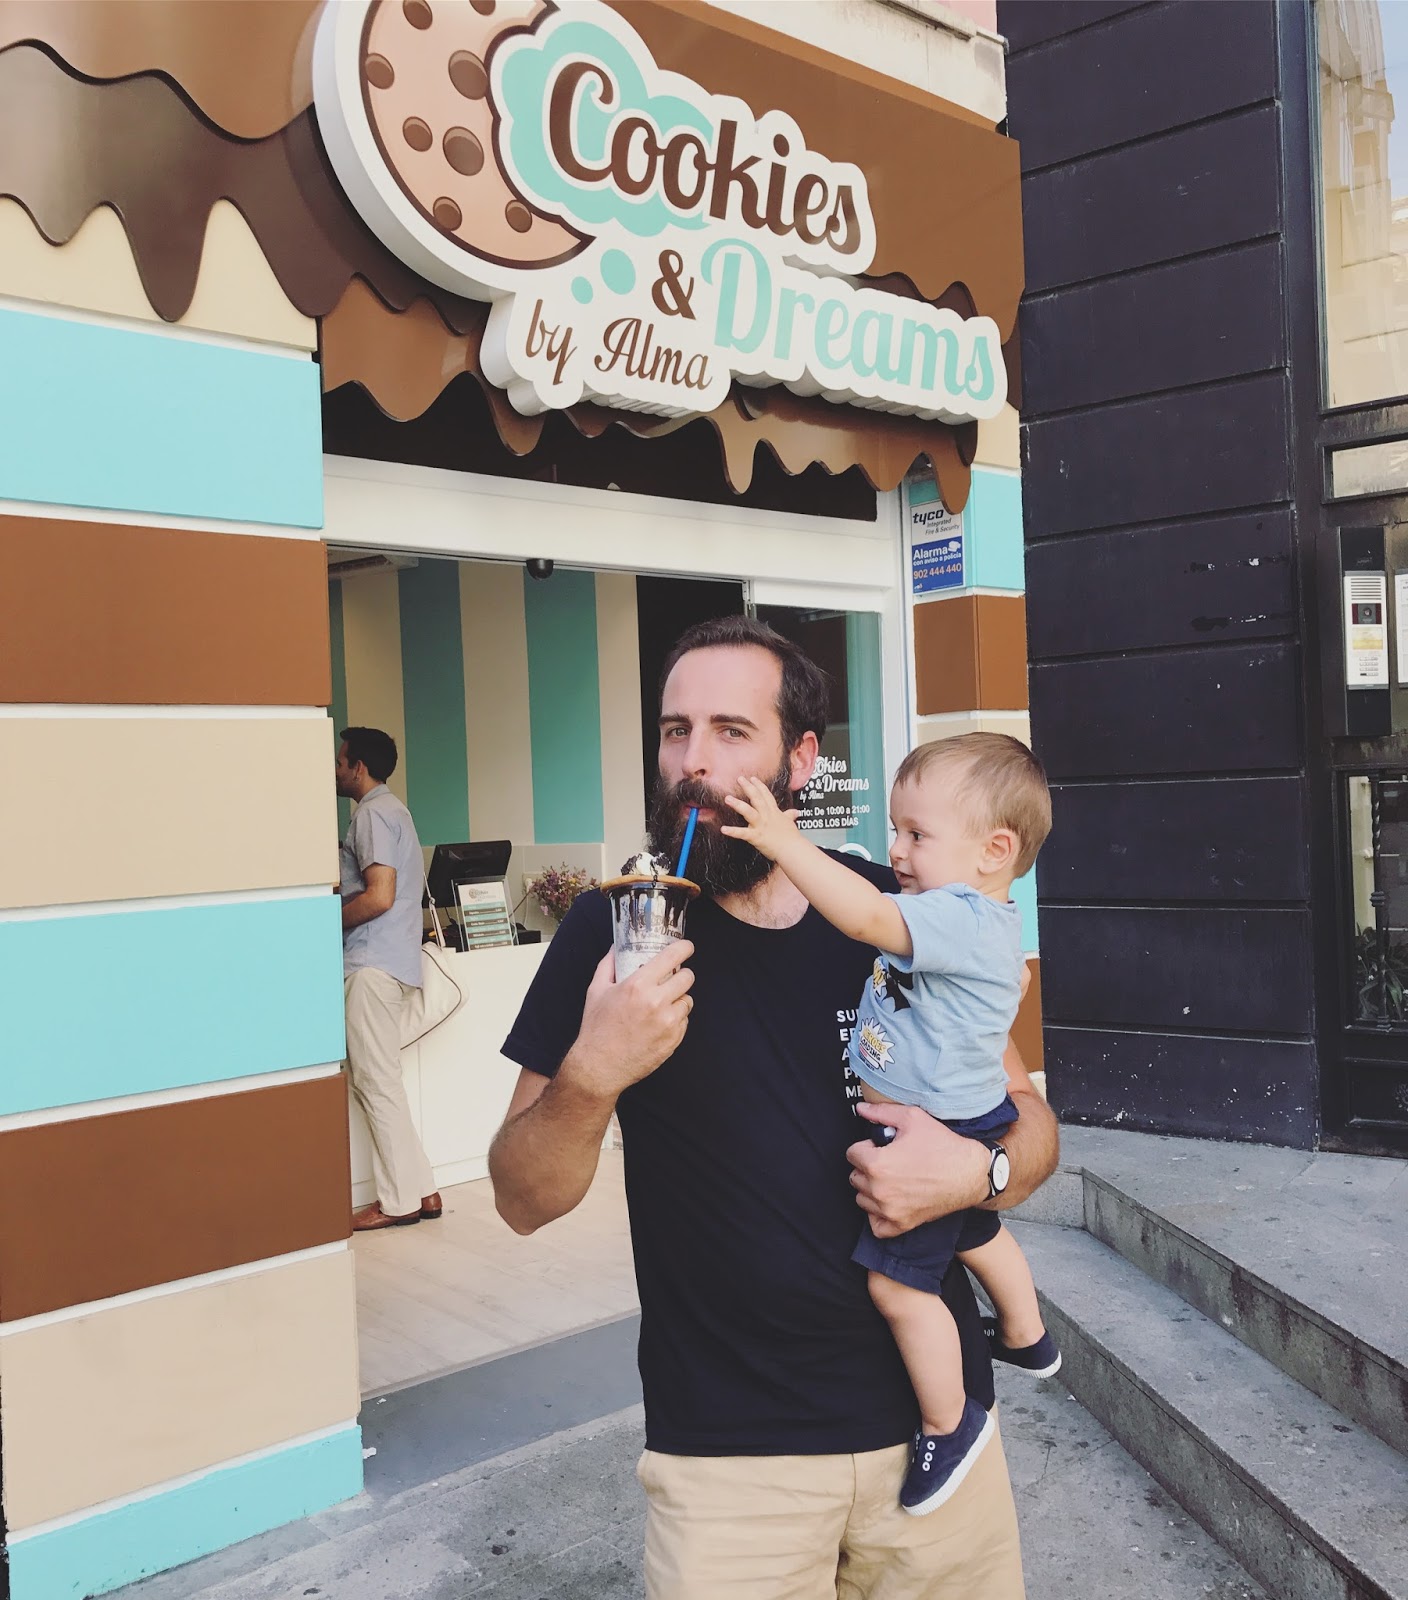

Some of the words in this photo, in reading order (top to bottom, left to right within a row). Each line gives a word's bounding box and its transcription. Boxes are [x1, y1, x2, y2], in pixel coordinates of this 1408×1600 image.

[549, 61, 862, 254] Cookies
[651, 248, 697, 320] &
[700, 238, 995, 400] Dreams
[526, 299, 577, 385] by
[594, 318, 713, 390] Alma
[913, 509, 944, 525] tyco
[927, 518, 952, 528] Integrated
[940, 524, 960, 532] Security
[913, 546, 948, 560] Alarma
[913, 569, 928, 579] 902
[929, 566, 945, 576] 444
[946, 563, 962, 573] 440
[814, 756, 847, 774] okies
[815, 779, 822, 790] &
[822, 773, 870, 792] Dreams
[800, 790, 807, 803] by
[808, 789, 825, 799] Alma
[814, 807, 825, 816] De
[826, 805, 845, 815] 10:00
[852, 804, 870, 814] 21:00
[797, 819, 823, 829] TODOS
[825, 817, 840, 828] LOS
[841, 815, 859, 827] DÍAS
